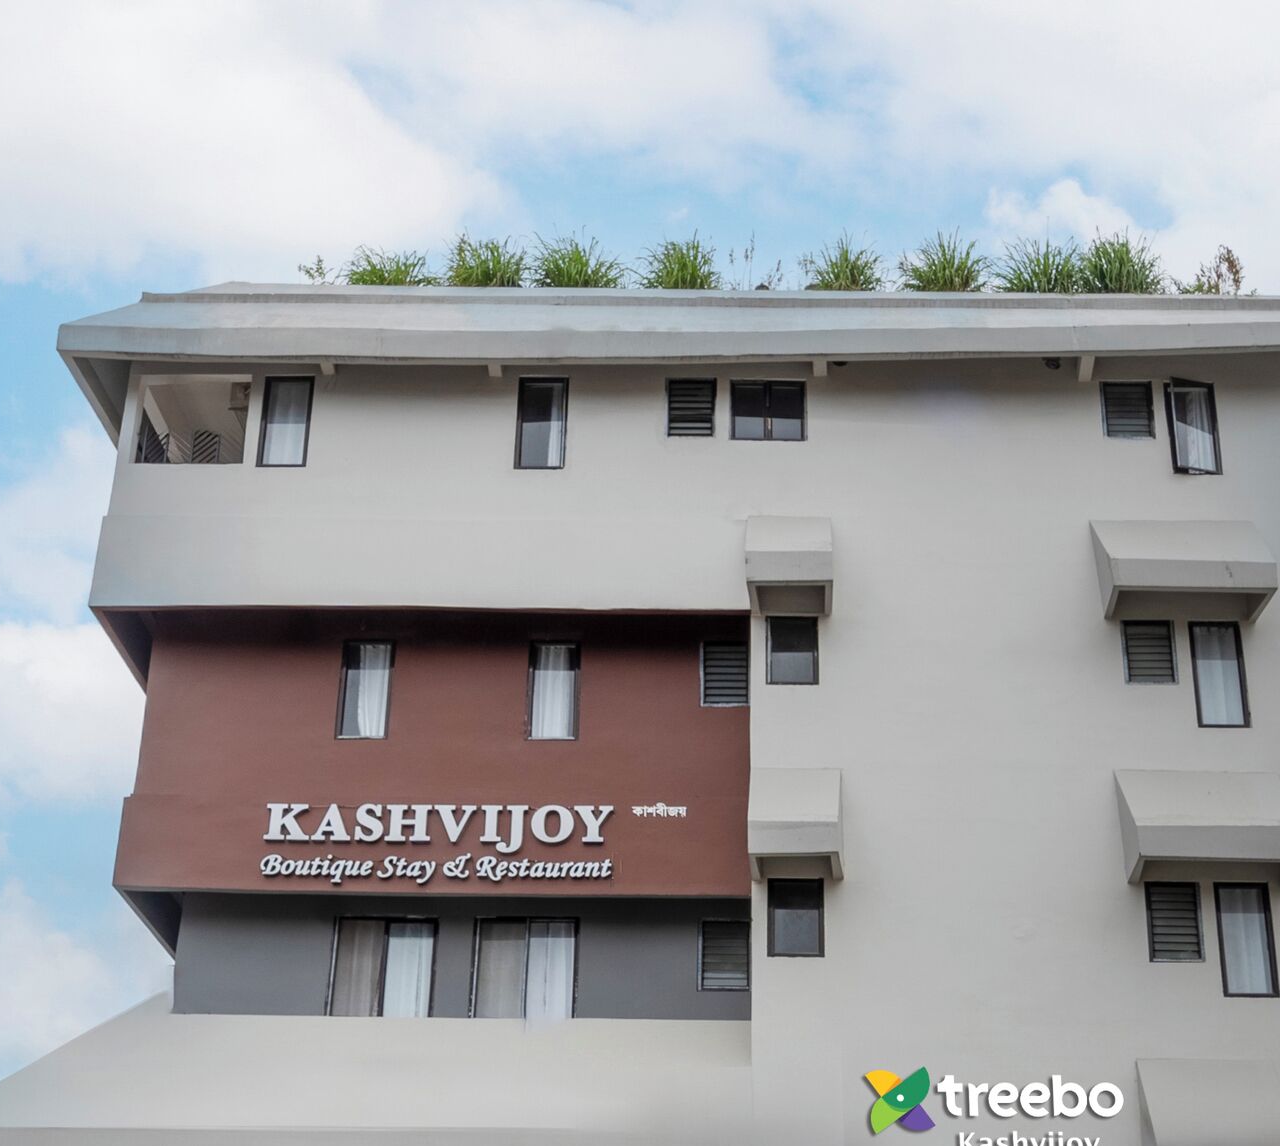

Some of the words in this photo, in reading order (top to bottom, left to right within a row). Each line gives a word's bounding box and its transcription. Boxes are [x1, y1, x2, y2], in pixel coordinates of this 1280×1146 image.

[263, 803, 614, 853] KASHVIJOY
[260, 854, 374, 884] Boutique
[376, 855, 436, 884] Stay
[442, 853, 471, 878] &
[475, 855, 612, 882] Restaurant
[937, 1074, 1125, 1118] treebo
